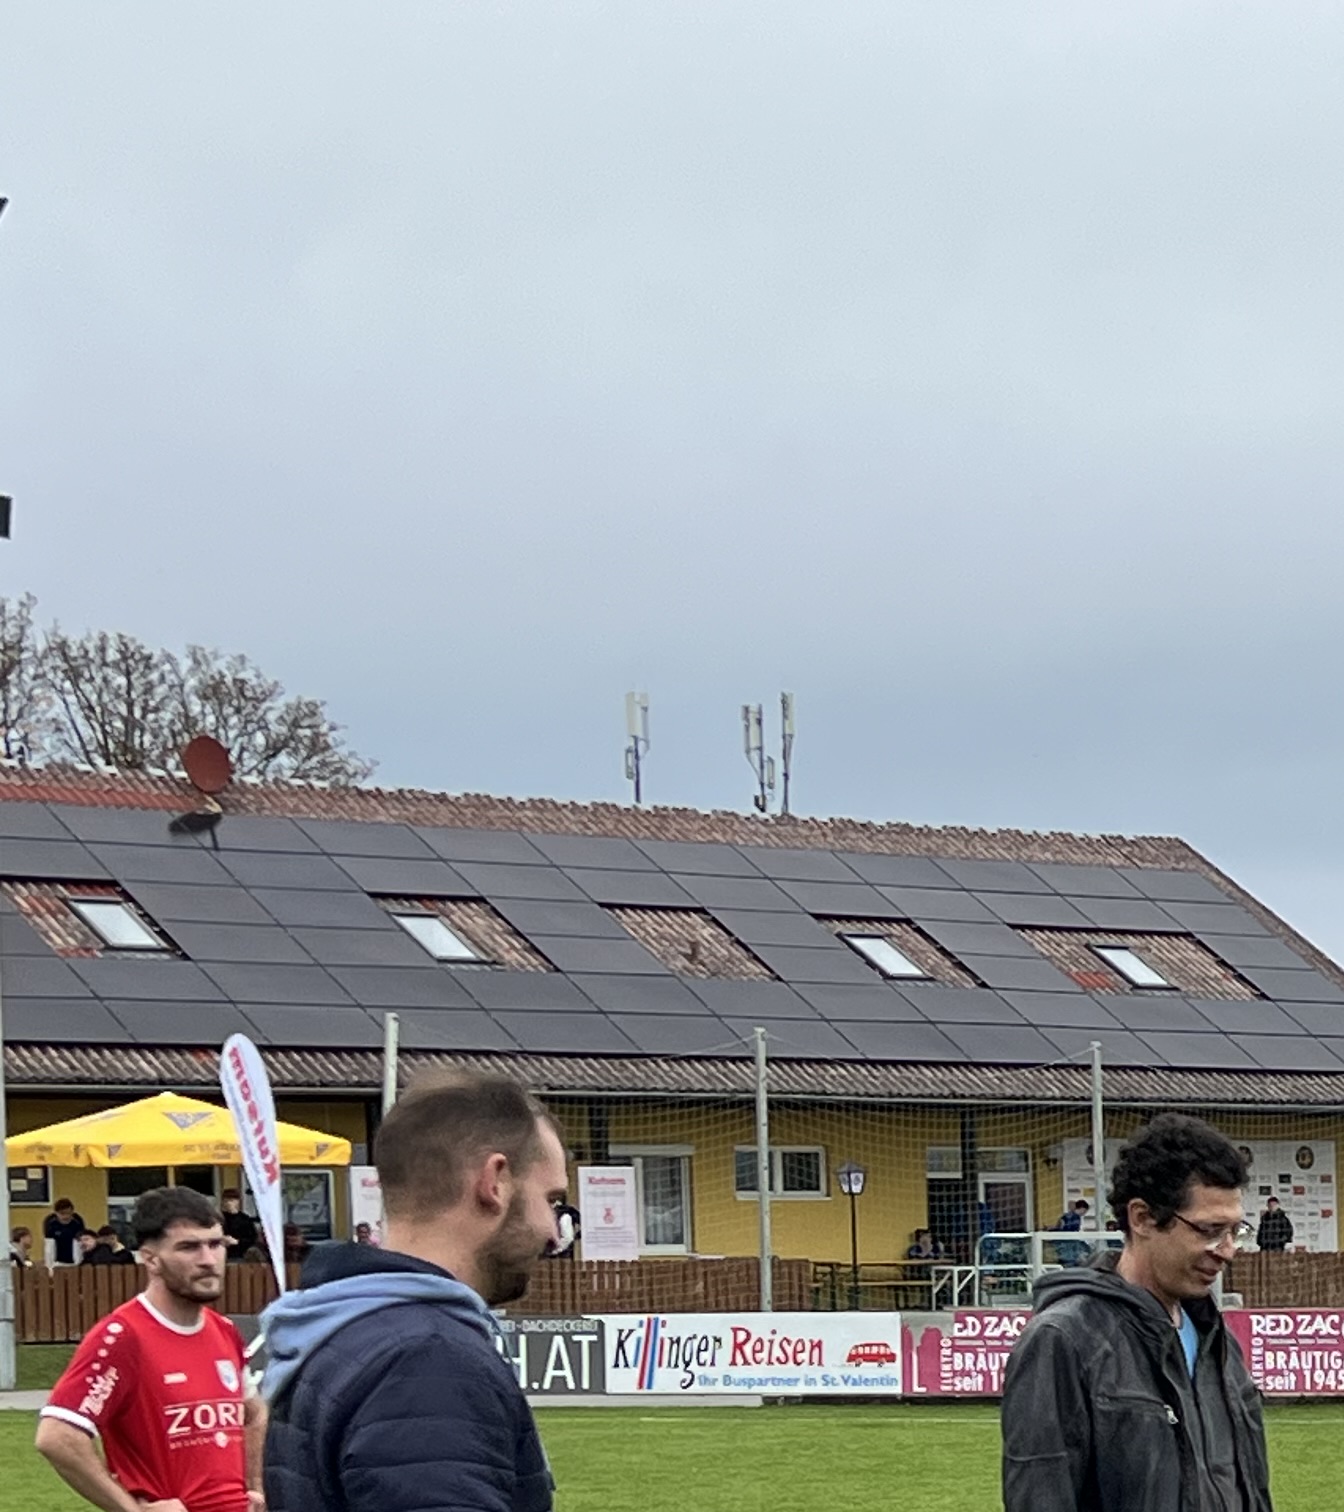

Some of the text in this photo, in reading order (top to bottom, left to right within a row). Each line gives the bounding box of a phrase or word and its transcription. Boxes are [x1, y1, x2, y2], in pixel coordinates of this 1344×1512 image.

[954, 1316, 982, 1337] ED
[1250, 1314, 1341, 1335] RED ZAC
[612, 1316, 824, 1390] Killinger Reisen
[722, 1374, 800, 1389] Buspartner
[804, 1374, 818, 1387] in
[953, 1372, 984, 1392] seit
[1265, 1370, 1298, 1391] seit
